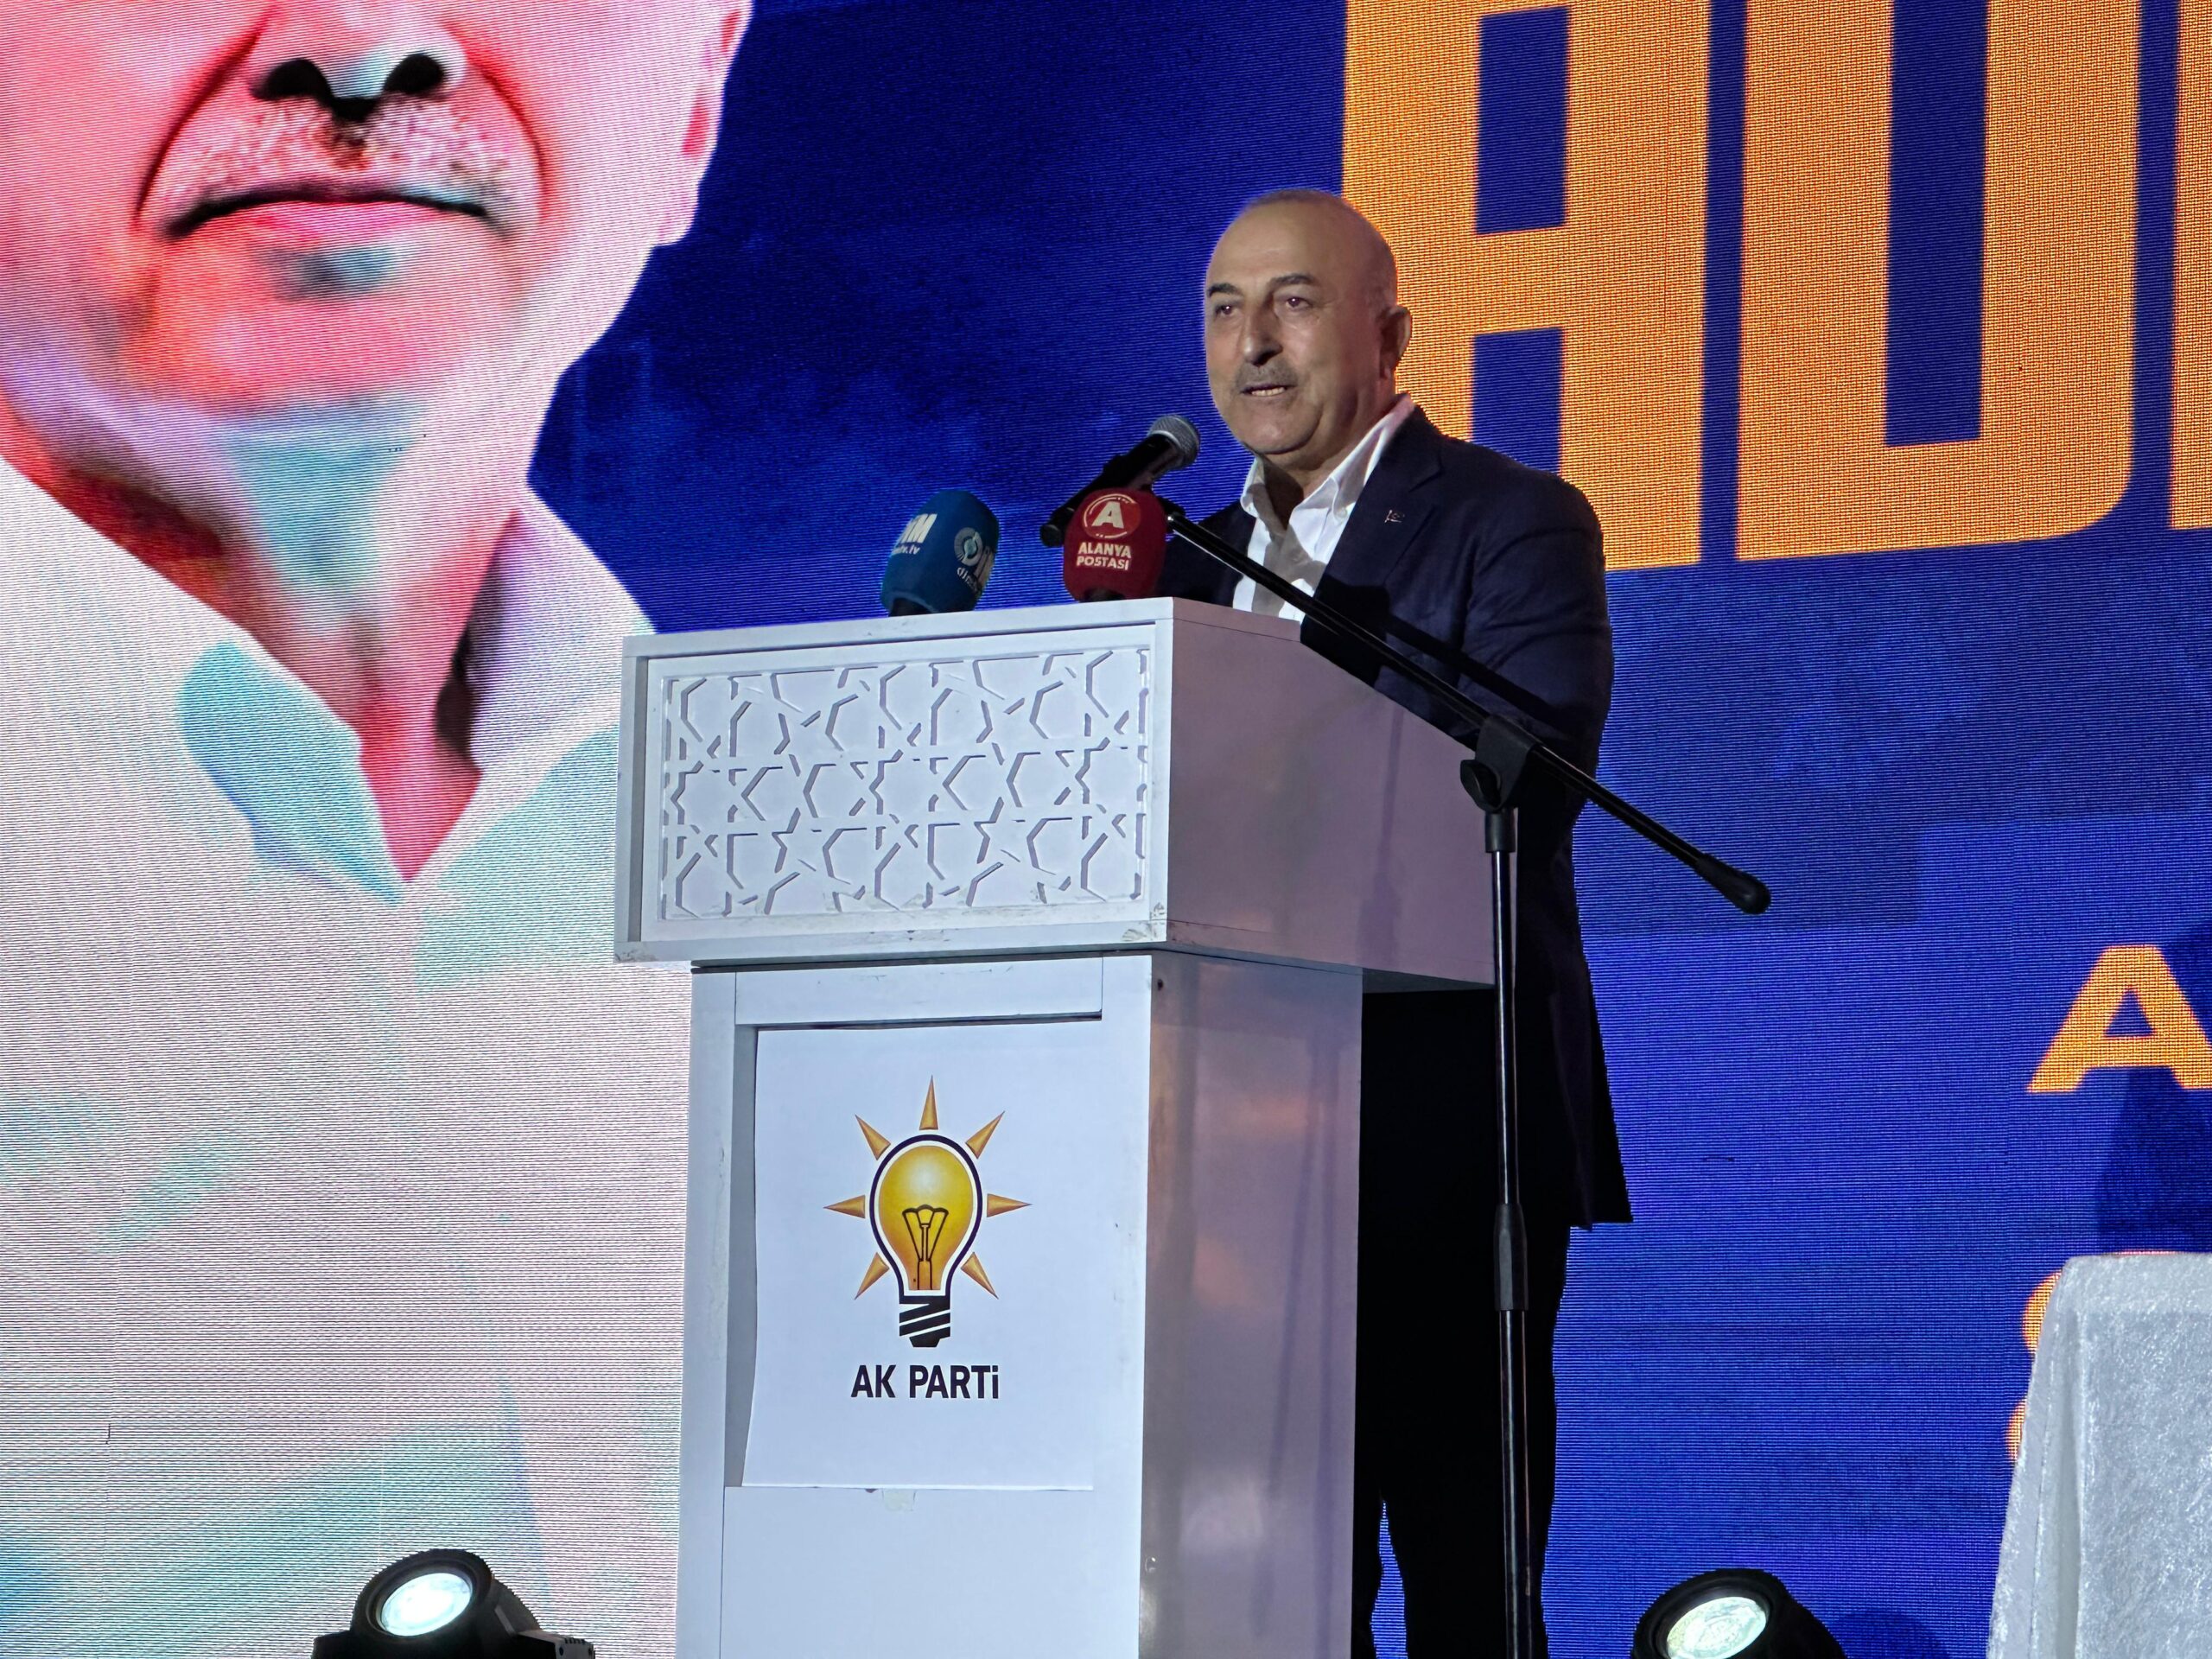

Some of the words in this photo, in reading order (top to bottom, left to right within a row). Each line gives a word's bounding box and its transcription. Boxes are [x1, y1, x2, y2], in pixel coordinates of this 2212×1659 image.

[1077, 542, 1132, 559] ALANYA
[1076, 556, 1129, 571] POSTASI
[850, 1364, 897, 1399] AK
